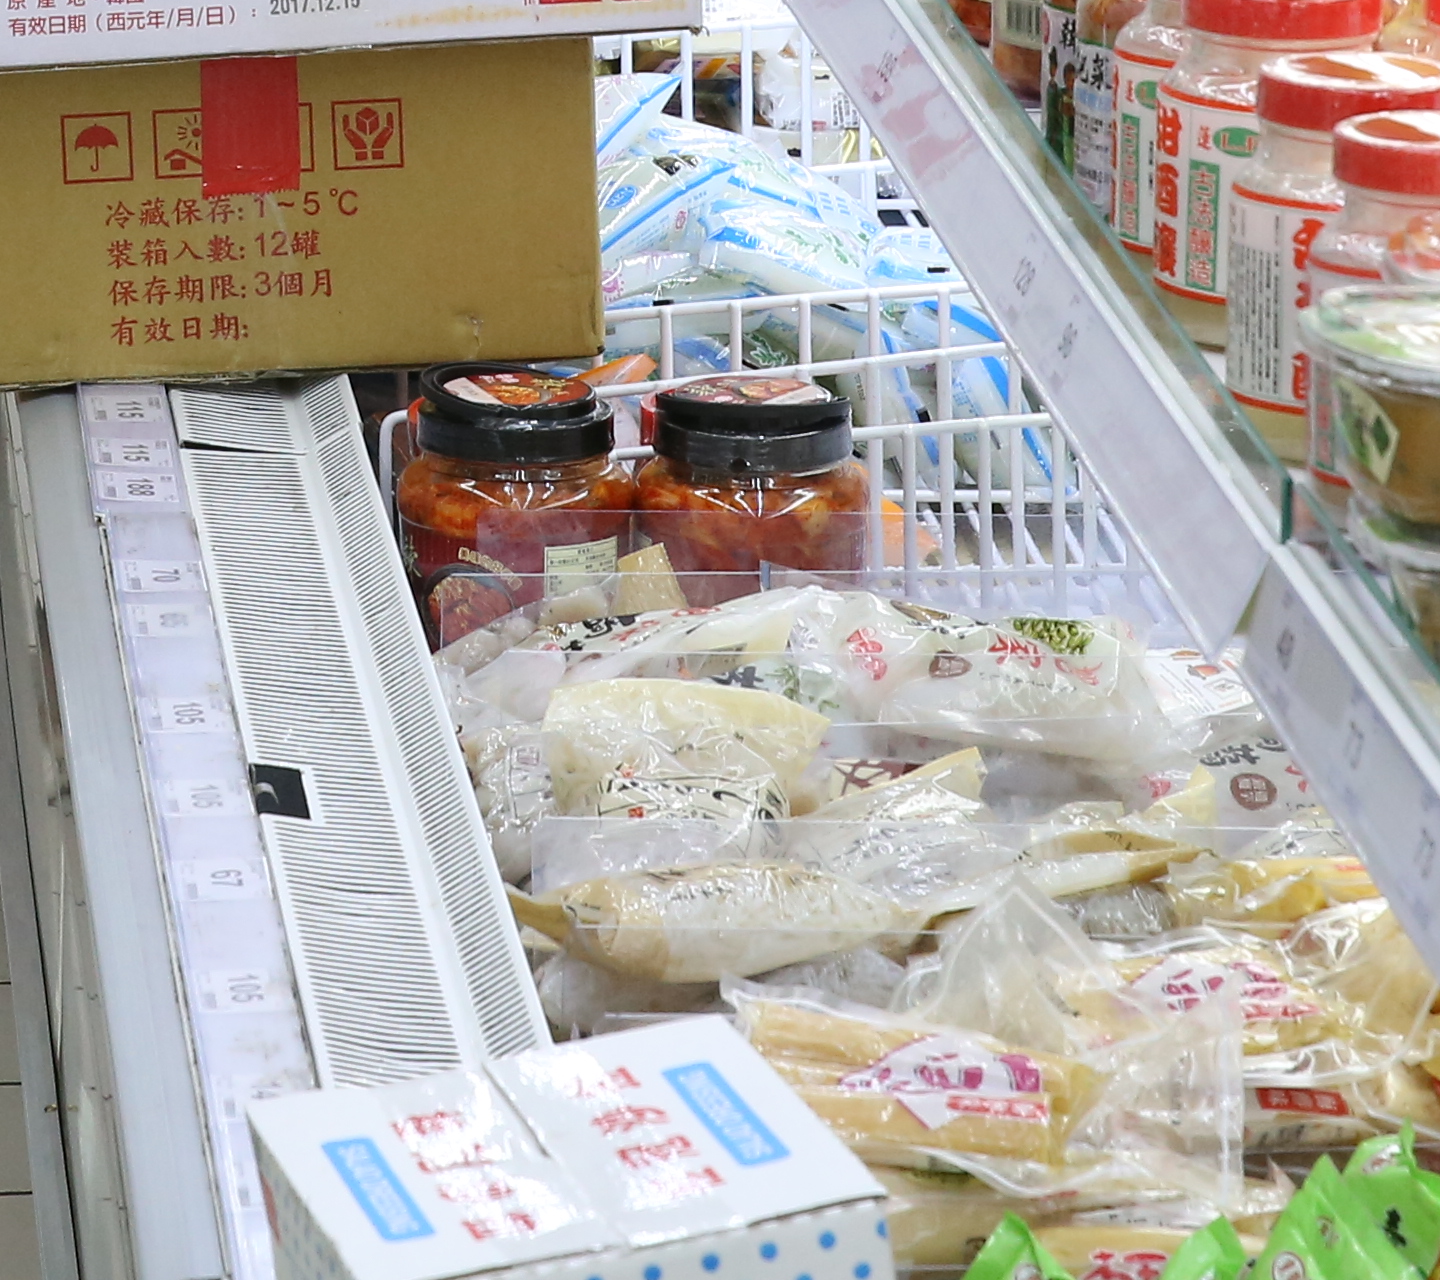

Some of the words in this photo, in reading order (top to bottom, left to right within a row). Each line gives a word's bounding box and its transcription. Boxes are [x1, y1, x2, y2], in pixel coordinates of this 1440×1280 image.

[254, 230, 321, 260] 12罐
[254, 268, 335, 298] 3個月
[116, 400, 145, 420] 115
[122, 443, 151, 463] 115
[126, 477, 156, 497] 188
[151, 567, 181, 584] 70
[172, 699, 207, 728] 105
[189, 782, 224, 811] 105
[210, 867, 245, 889] 67
[226, 972, 265, 1004] 105
